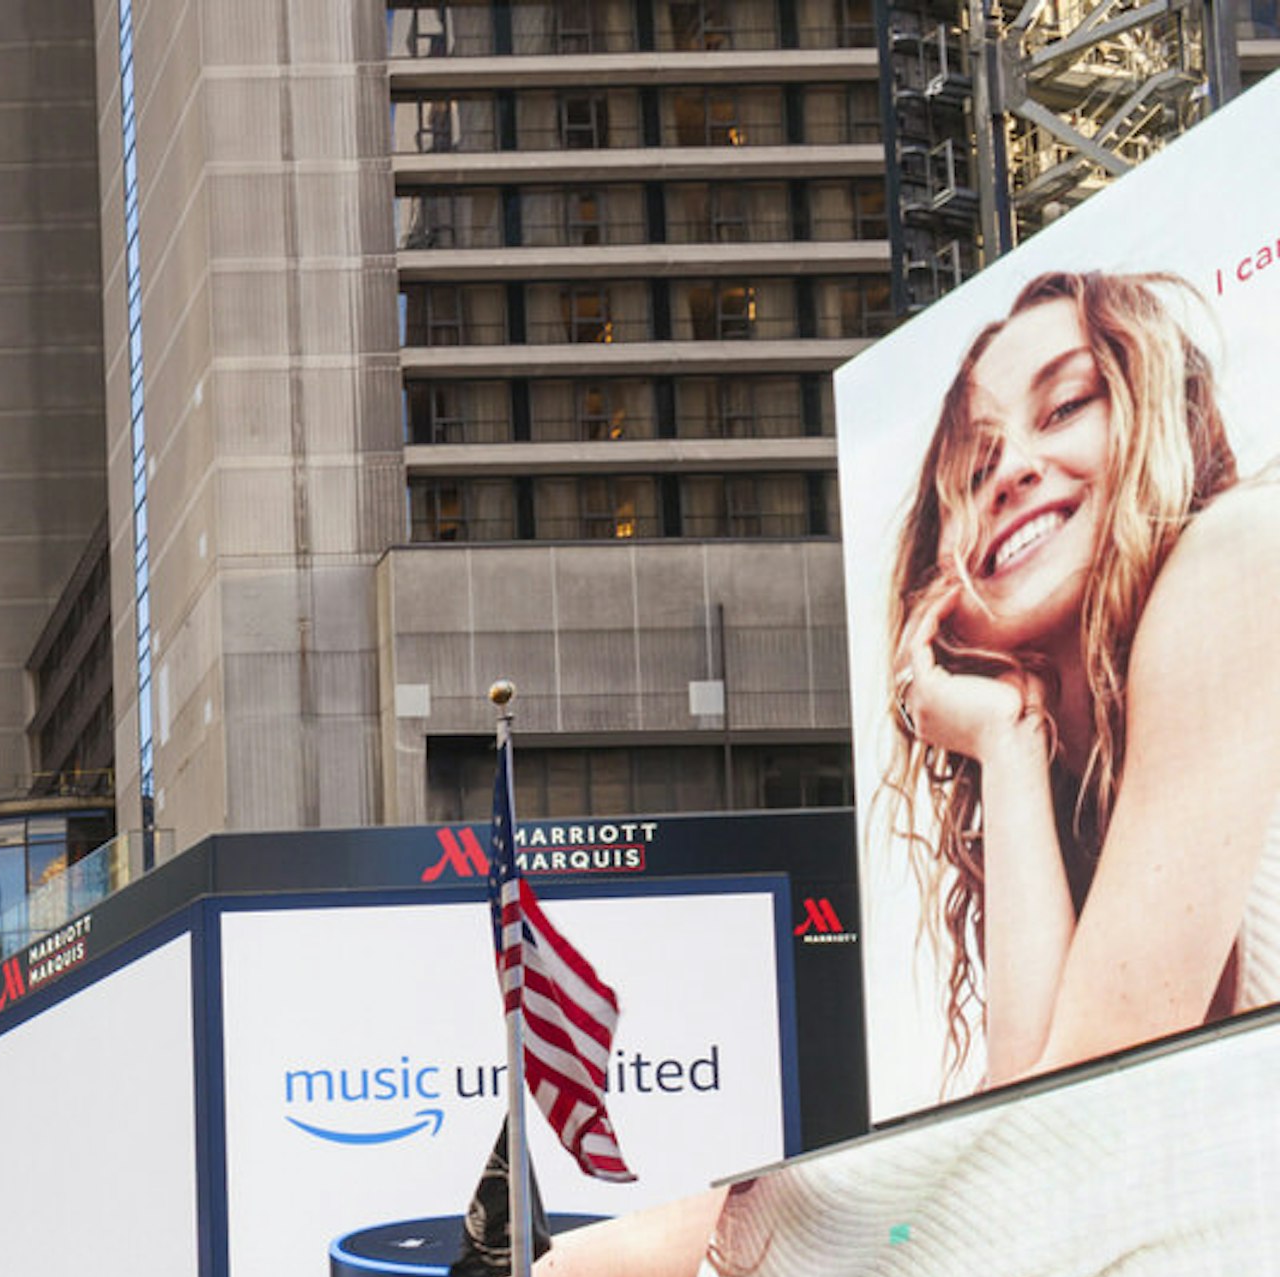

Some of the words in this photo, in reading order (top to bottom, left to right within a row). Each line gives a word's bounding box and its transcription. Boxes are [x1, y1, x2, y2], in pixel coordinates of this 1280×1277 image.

[29, 914, 92, 964] MARRIOTT
[29, 942, 85, 986] MARQUIS
[285, 1056, 441, 1103] music
[457, 1046, 721, 1099] united
